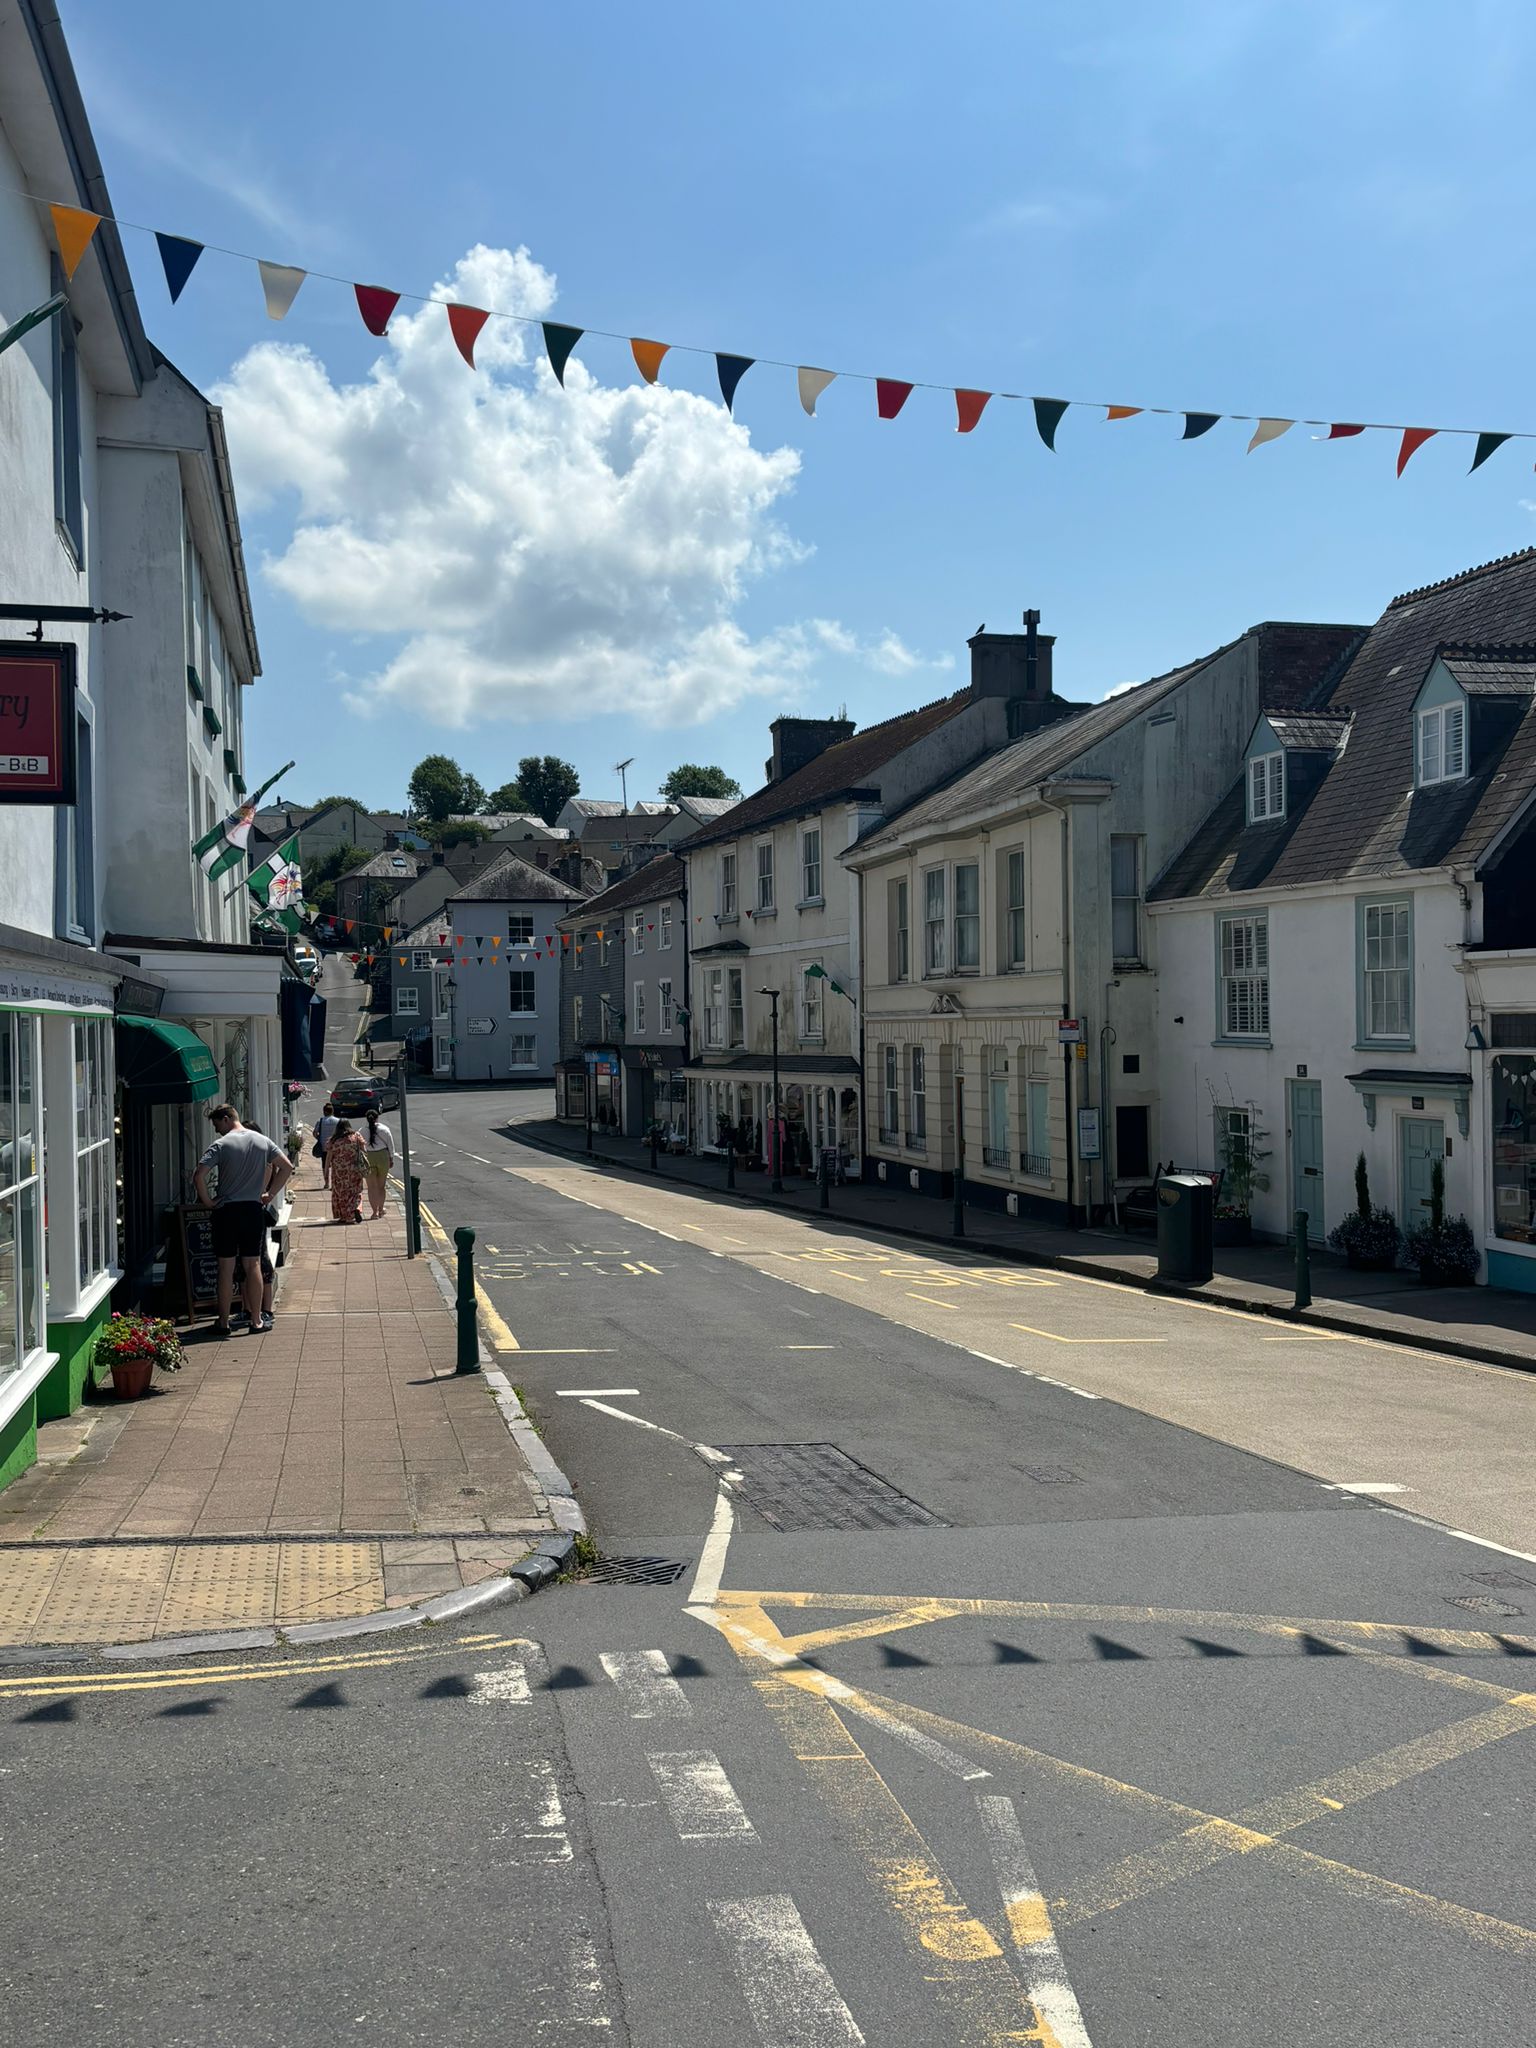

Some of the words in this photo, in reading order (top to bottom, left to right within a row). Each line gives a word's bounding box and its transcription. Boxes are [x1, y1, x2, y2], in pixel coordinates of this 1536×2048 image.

[485, 1241, 631, 1257] BUS
[798, 1247, 976, 1262] STOP
[879, 1269, 1061, 1286] BUS
